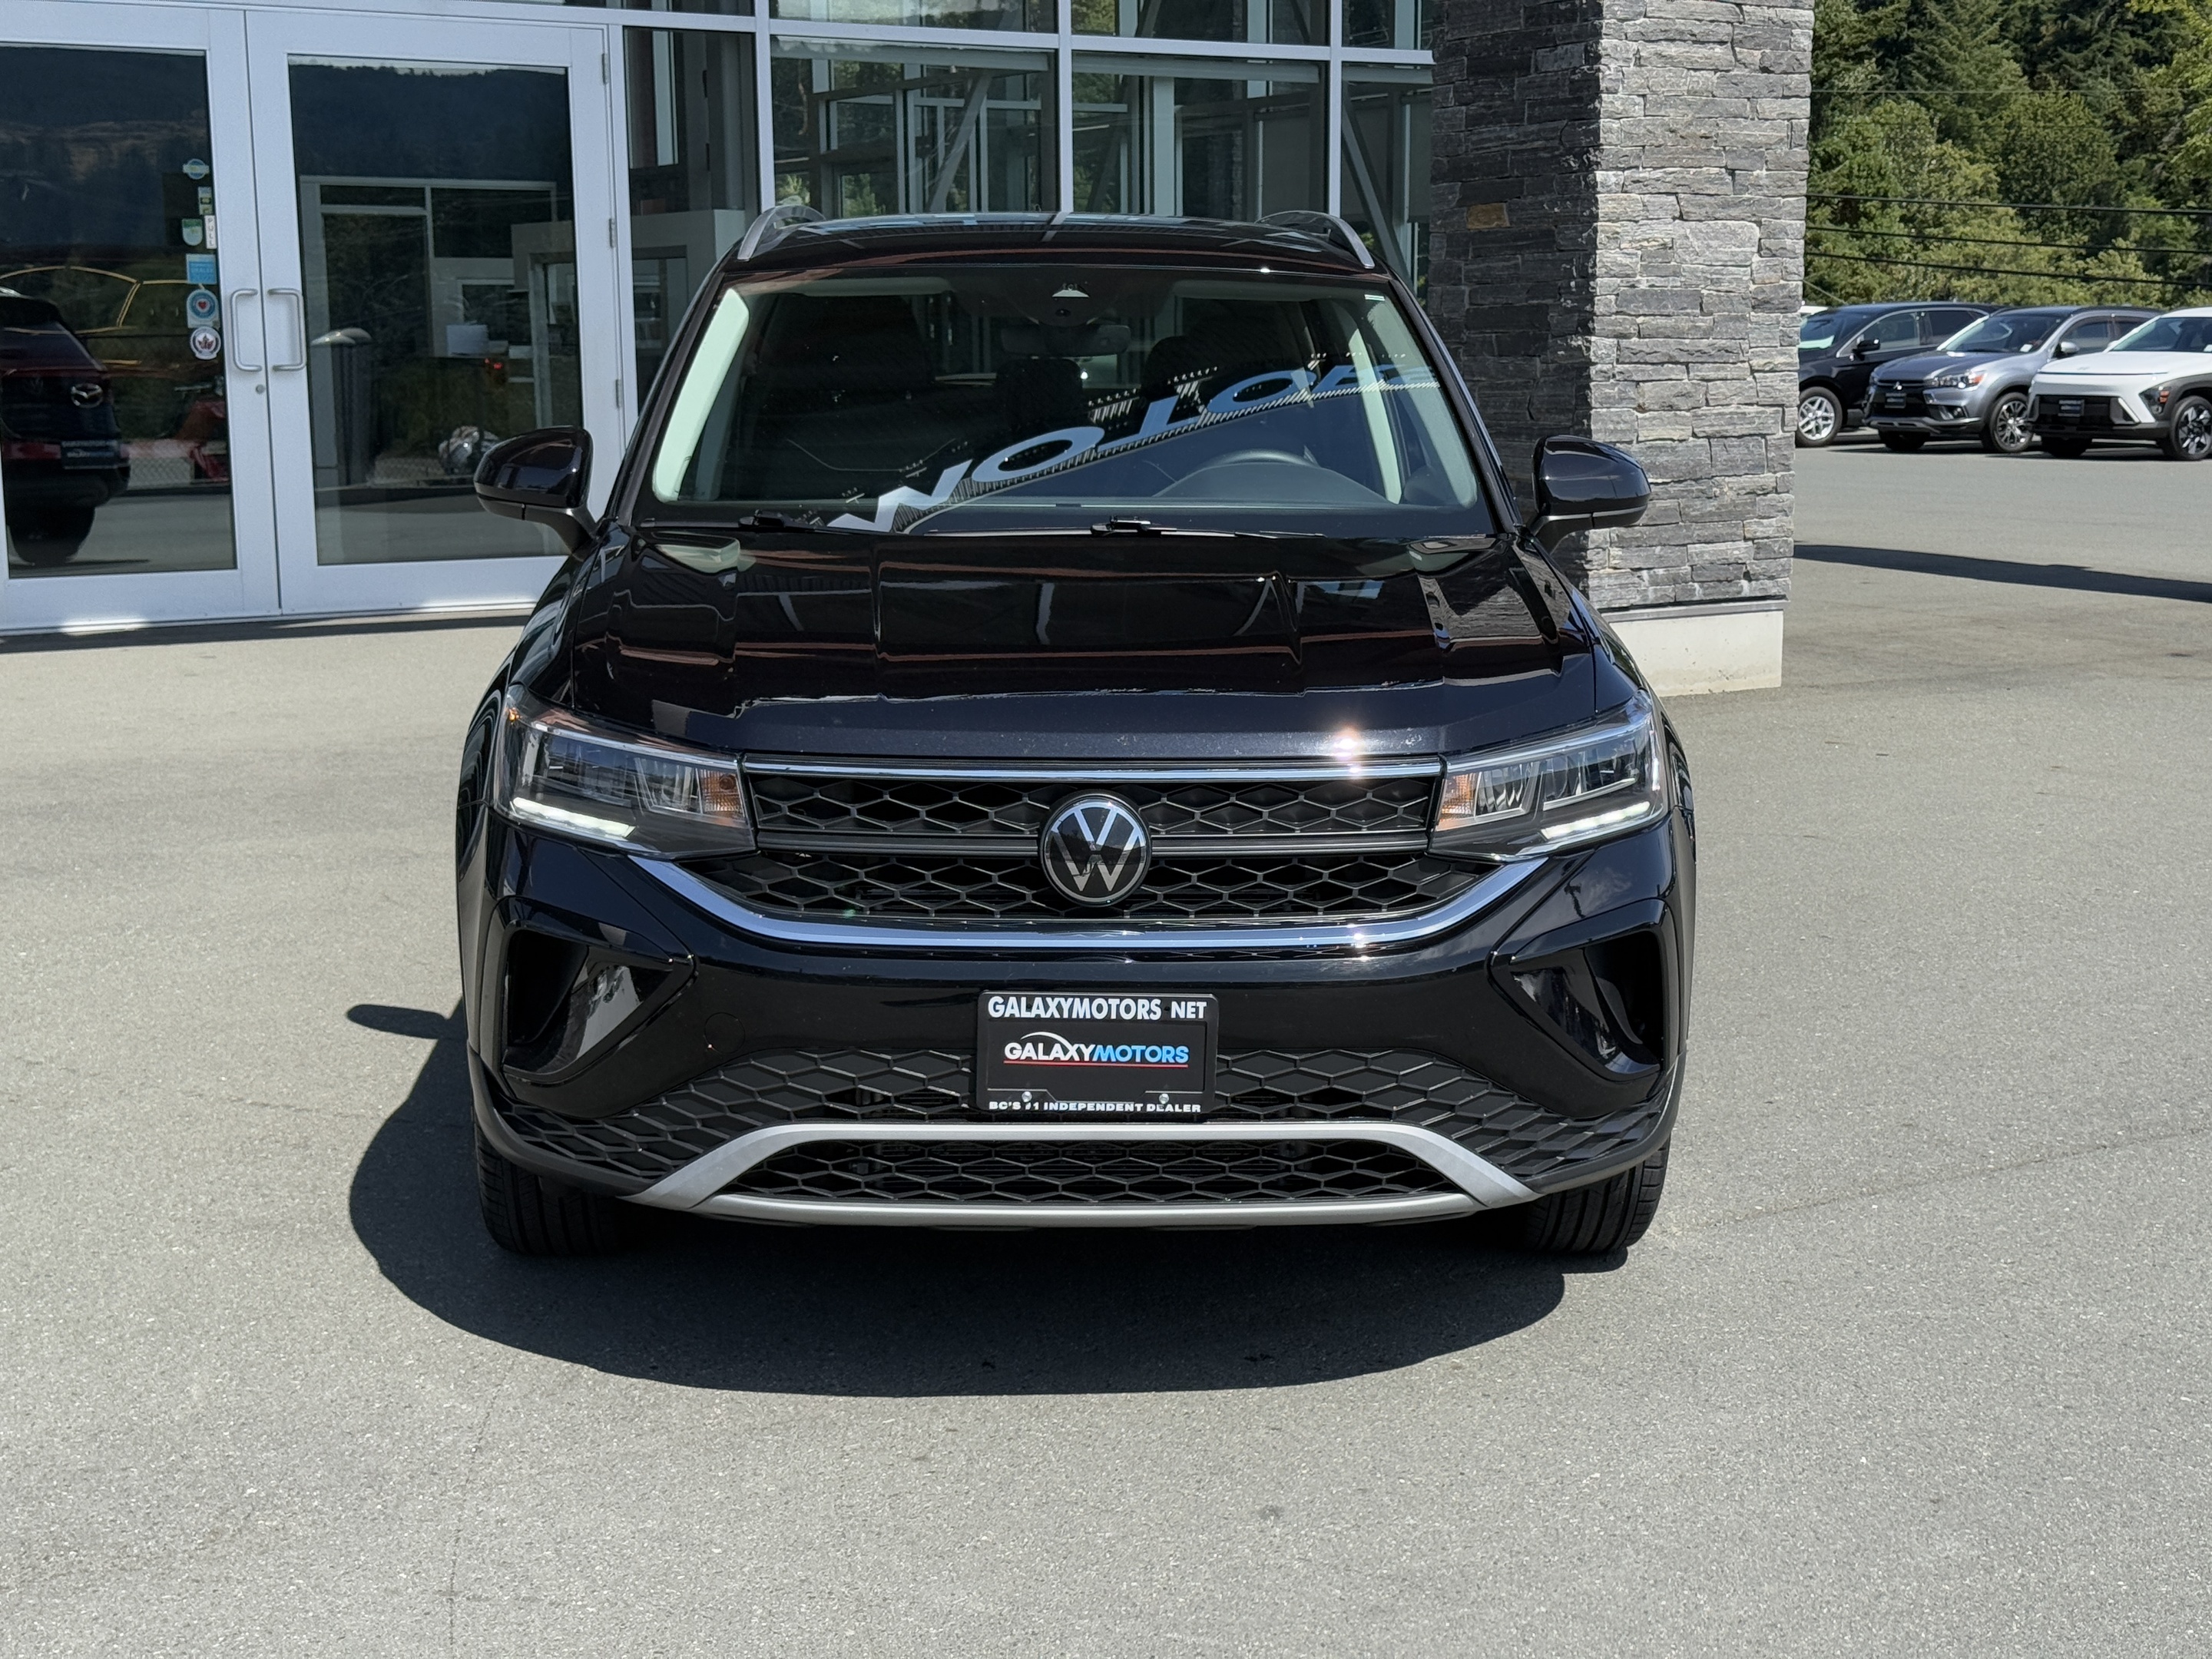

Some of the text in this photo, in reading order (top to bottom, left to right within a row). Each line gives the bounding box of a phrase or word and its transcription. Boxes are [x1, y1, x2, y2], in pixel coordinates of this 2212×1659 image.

[988, 996, 1207, 1020] GALAXYMOTORS NET
[1004, 1041, 1190, 1064] GALAXYMOTORS
[988, 1101, 1022, 1111] BC'S
[1042, 1101, 1144, 1112] INDEPENDENT
[1146, 1103, 1201, 1113] DEALER
